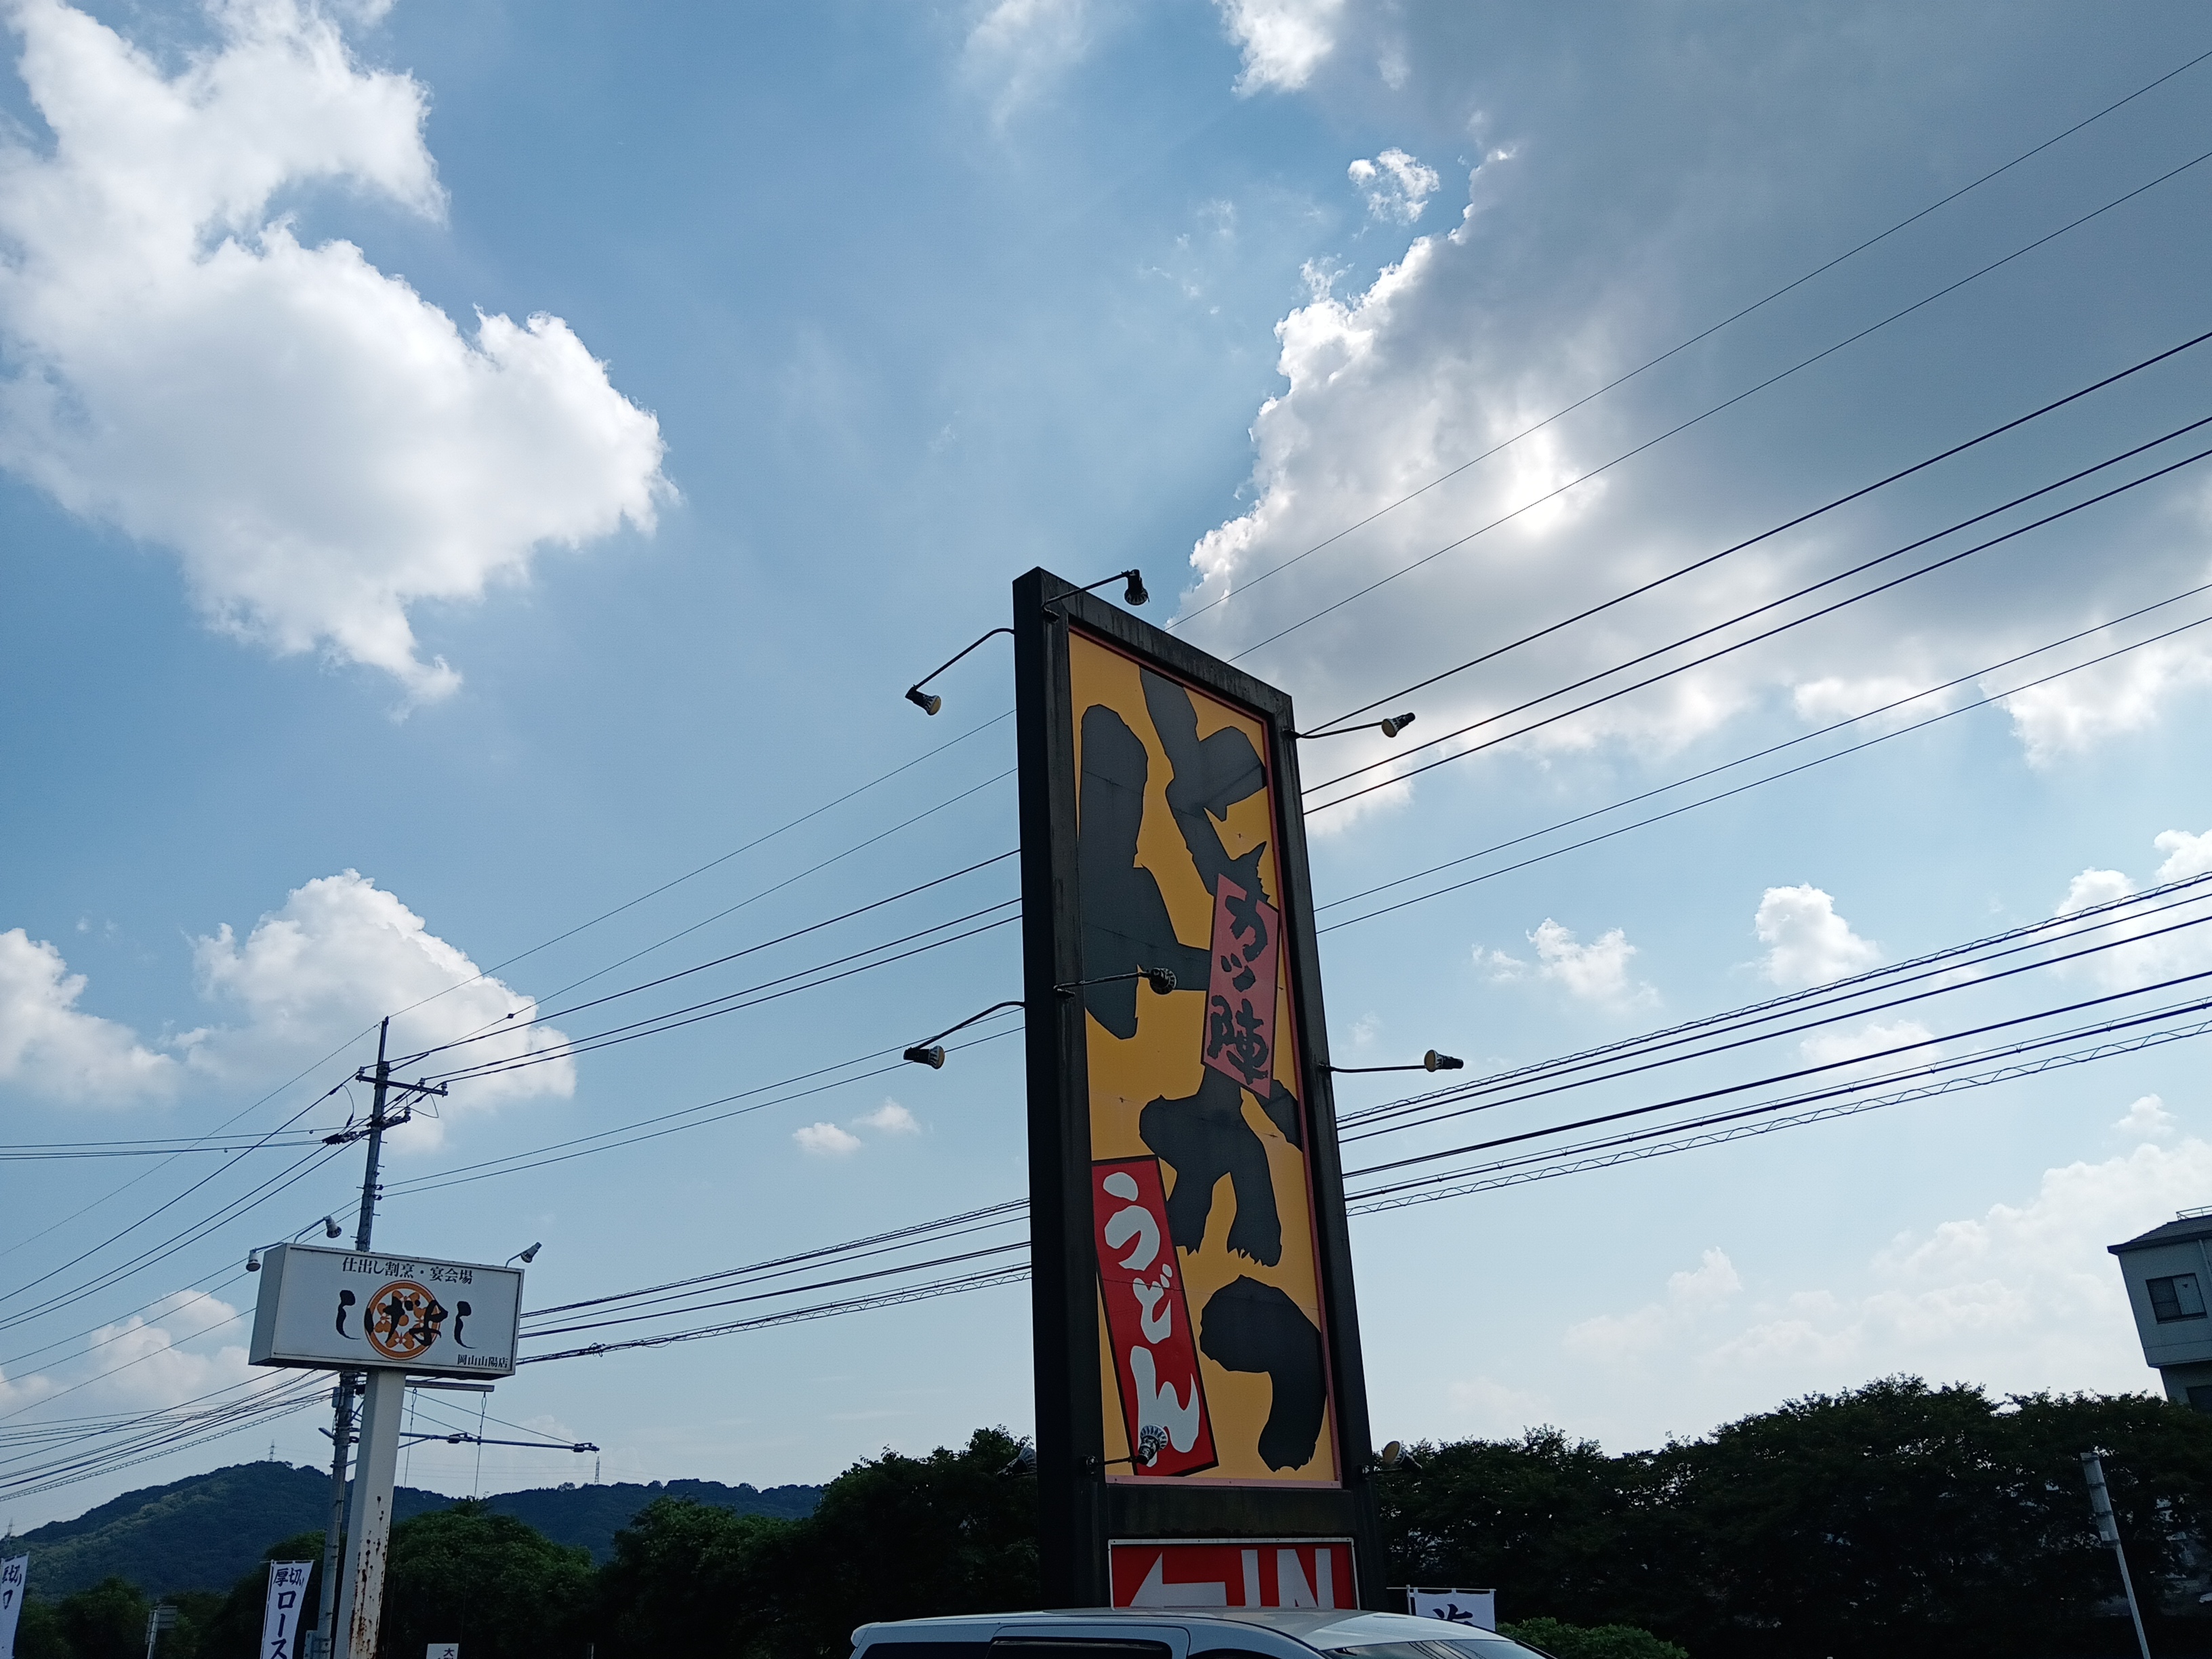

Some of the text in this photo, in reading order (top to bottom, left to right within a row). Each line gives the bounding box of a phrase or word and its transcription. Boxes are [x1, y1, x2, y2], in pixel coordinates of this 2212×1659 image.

[342, 1256, 473, 1285] 仕出し割烹・宴会場
[335, 1289, 476, 1349] しげよし
[1103, 1171, 1201, 1468] うどん
[457, 1354, 508, 1368] 岡山山陽店
[273, 1567, 305, 1588] 厚切り
[1241, 1548, 1334, 1609] IN
[270, 1590, 297, 1659] ロース
